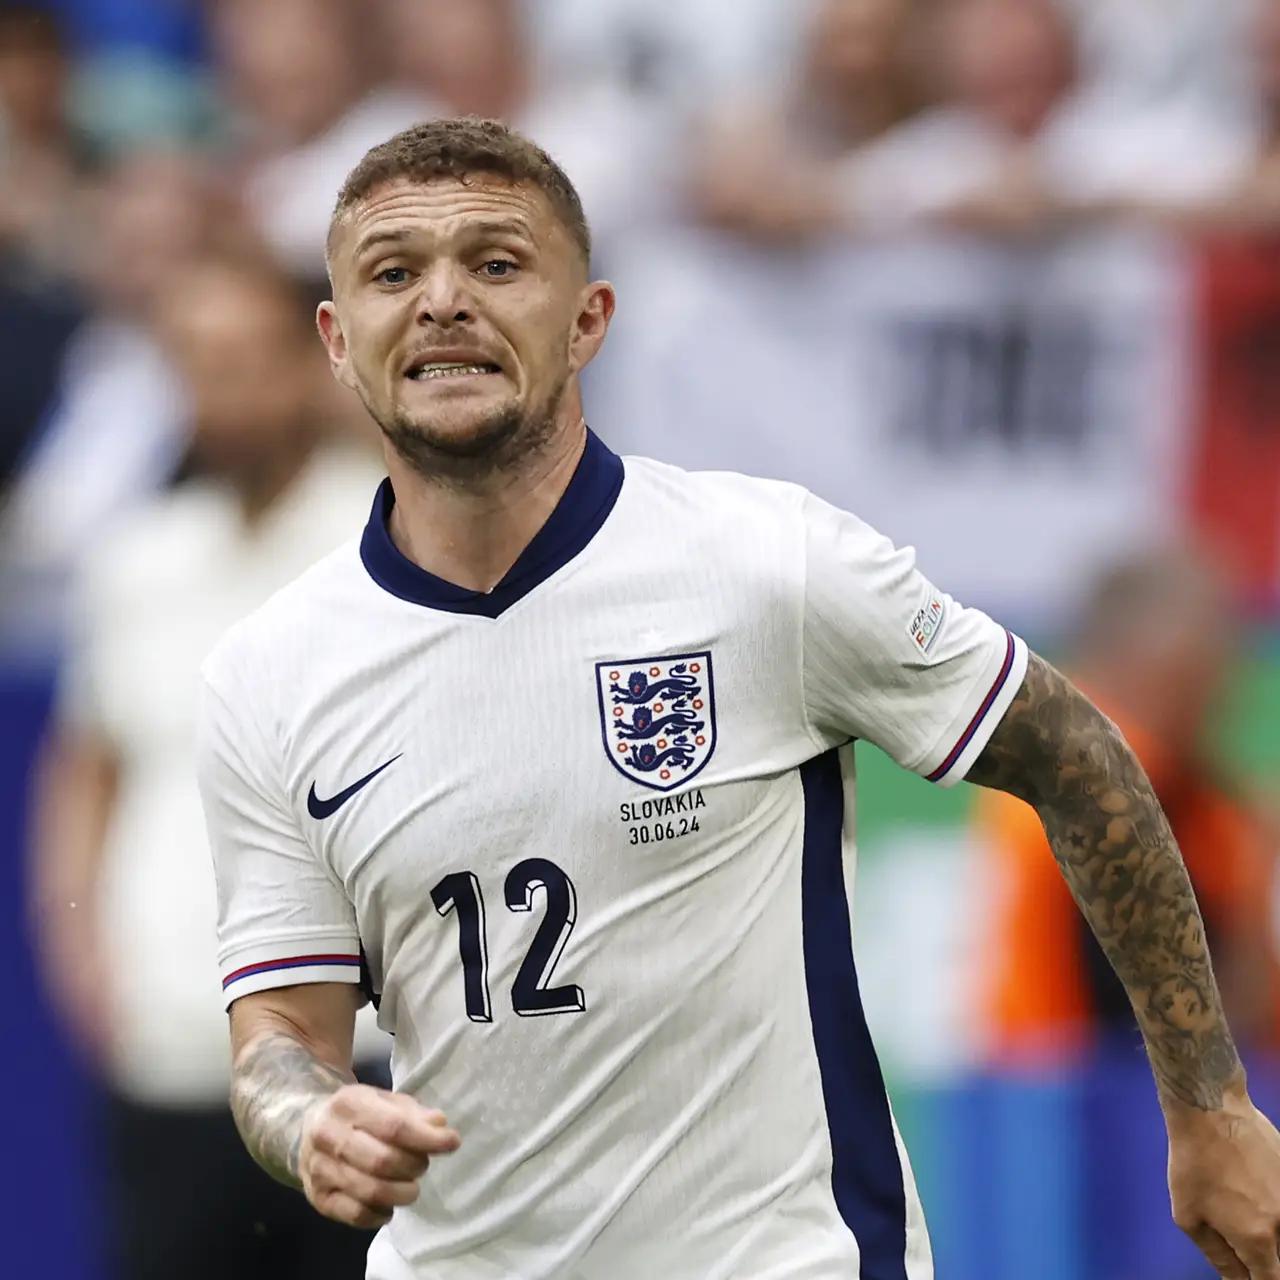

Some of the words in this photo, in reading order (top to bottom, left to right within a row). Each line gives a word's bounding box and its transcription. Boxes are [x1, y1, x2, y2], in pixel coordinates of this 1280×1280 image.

[620, 789, 707, 822] SLOVAKIA
[629, 815, 700, 845] 30.06.24
[429, 857, 586, 1023] 12
